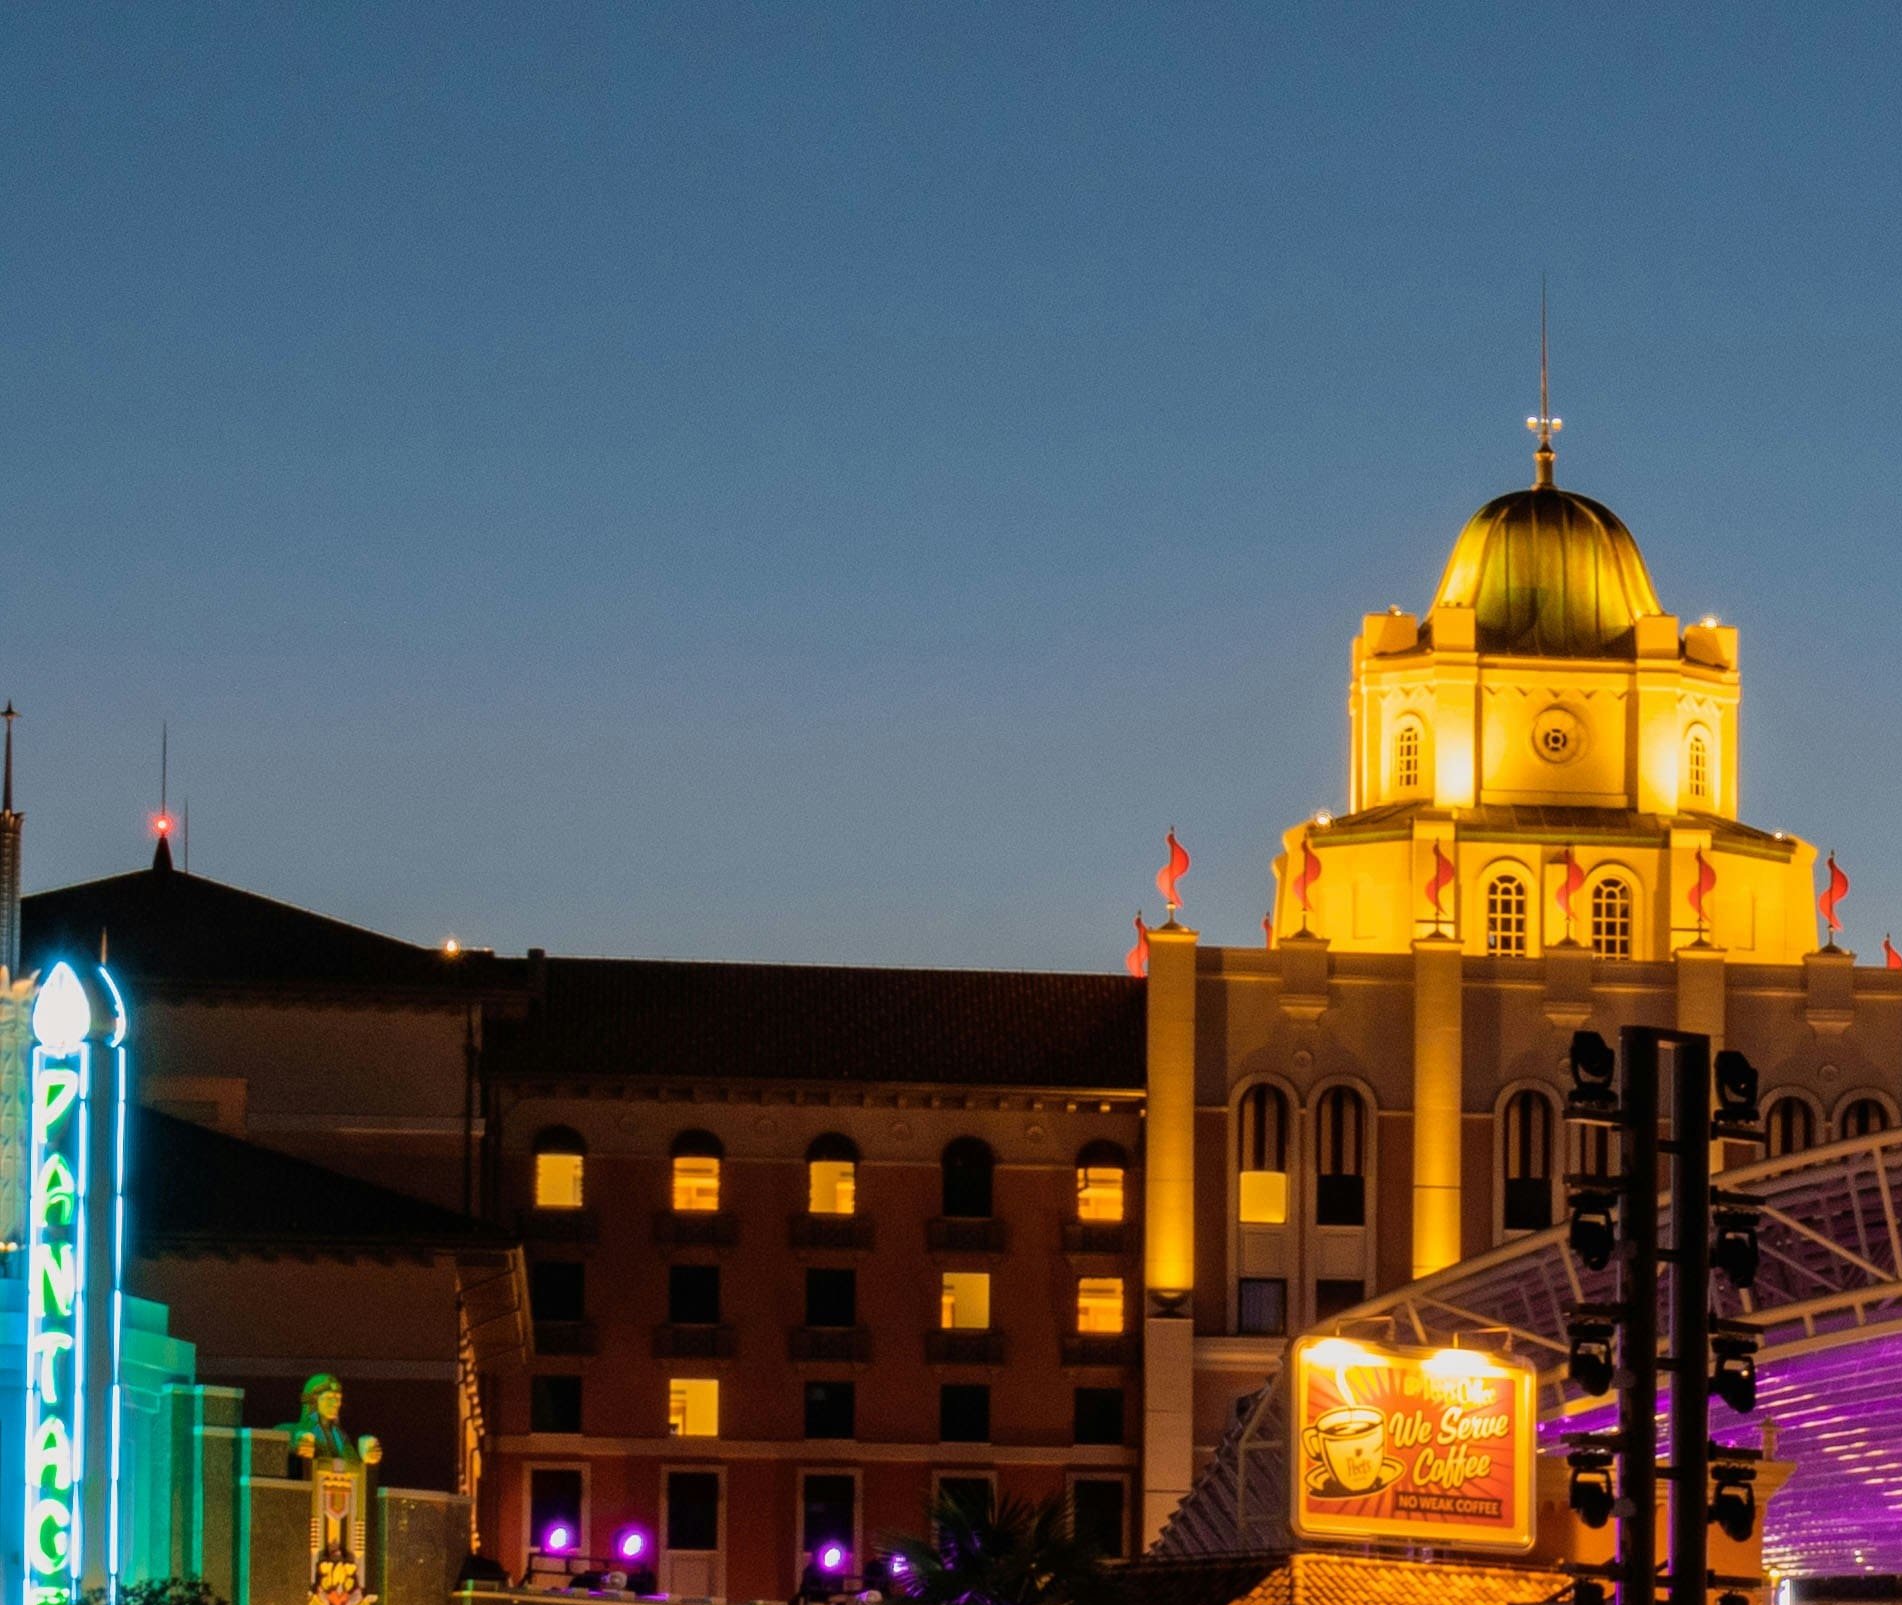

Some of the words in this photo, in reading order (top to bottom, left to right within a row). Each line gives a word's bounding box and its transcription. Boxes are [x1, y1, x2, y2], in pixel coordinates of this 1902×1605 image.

[1390, 1411, 1433, 1448] We
[1437, 1406, 1510, 1445] Serve
[1414, 1444, 1490, 1489] Coffee
[1399, 1495, 1417, 1509] NO
[1421, 1498, 1454, 1512] WEAK
[1455, 1499, 1499, 1515] COFFEE
